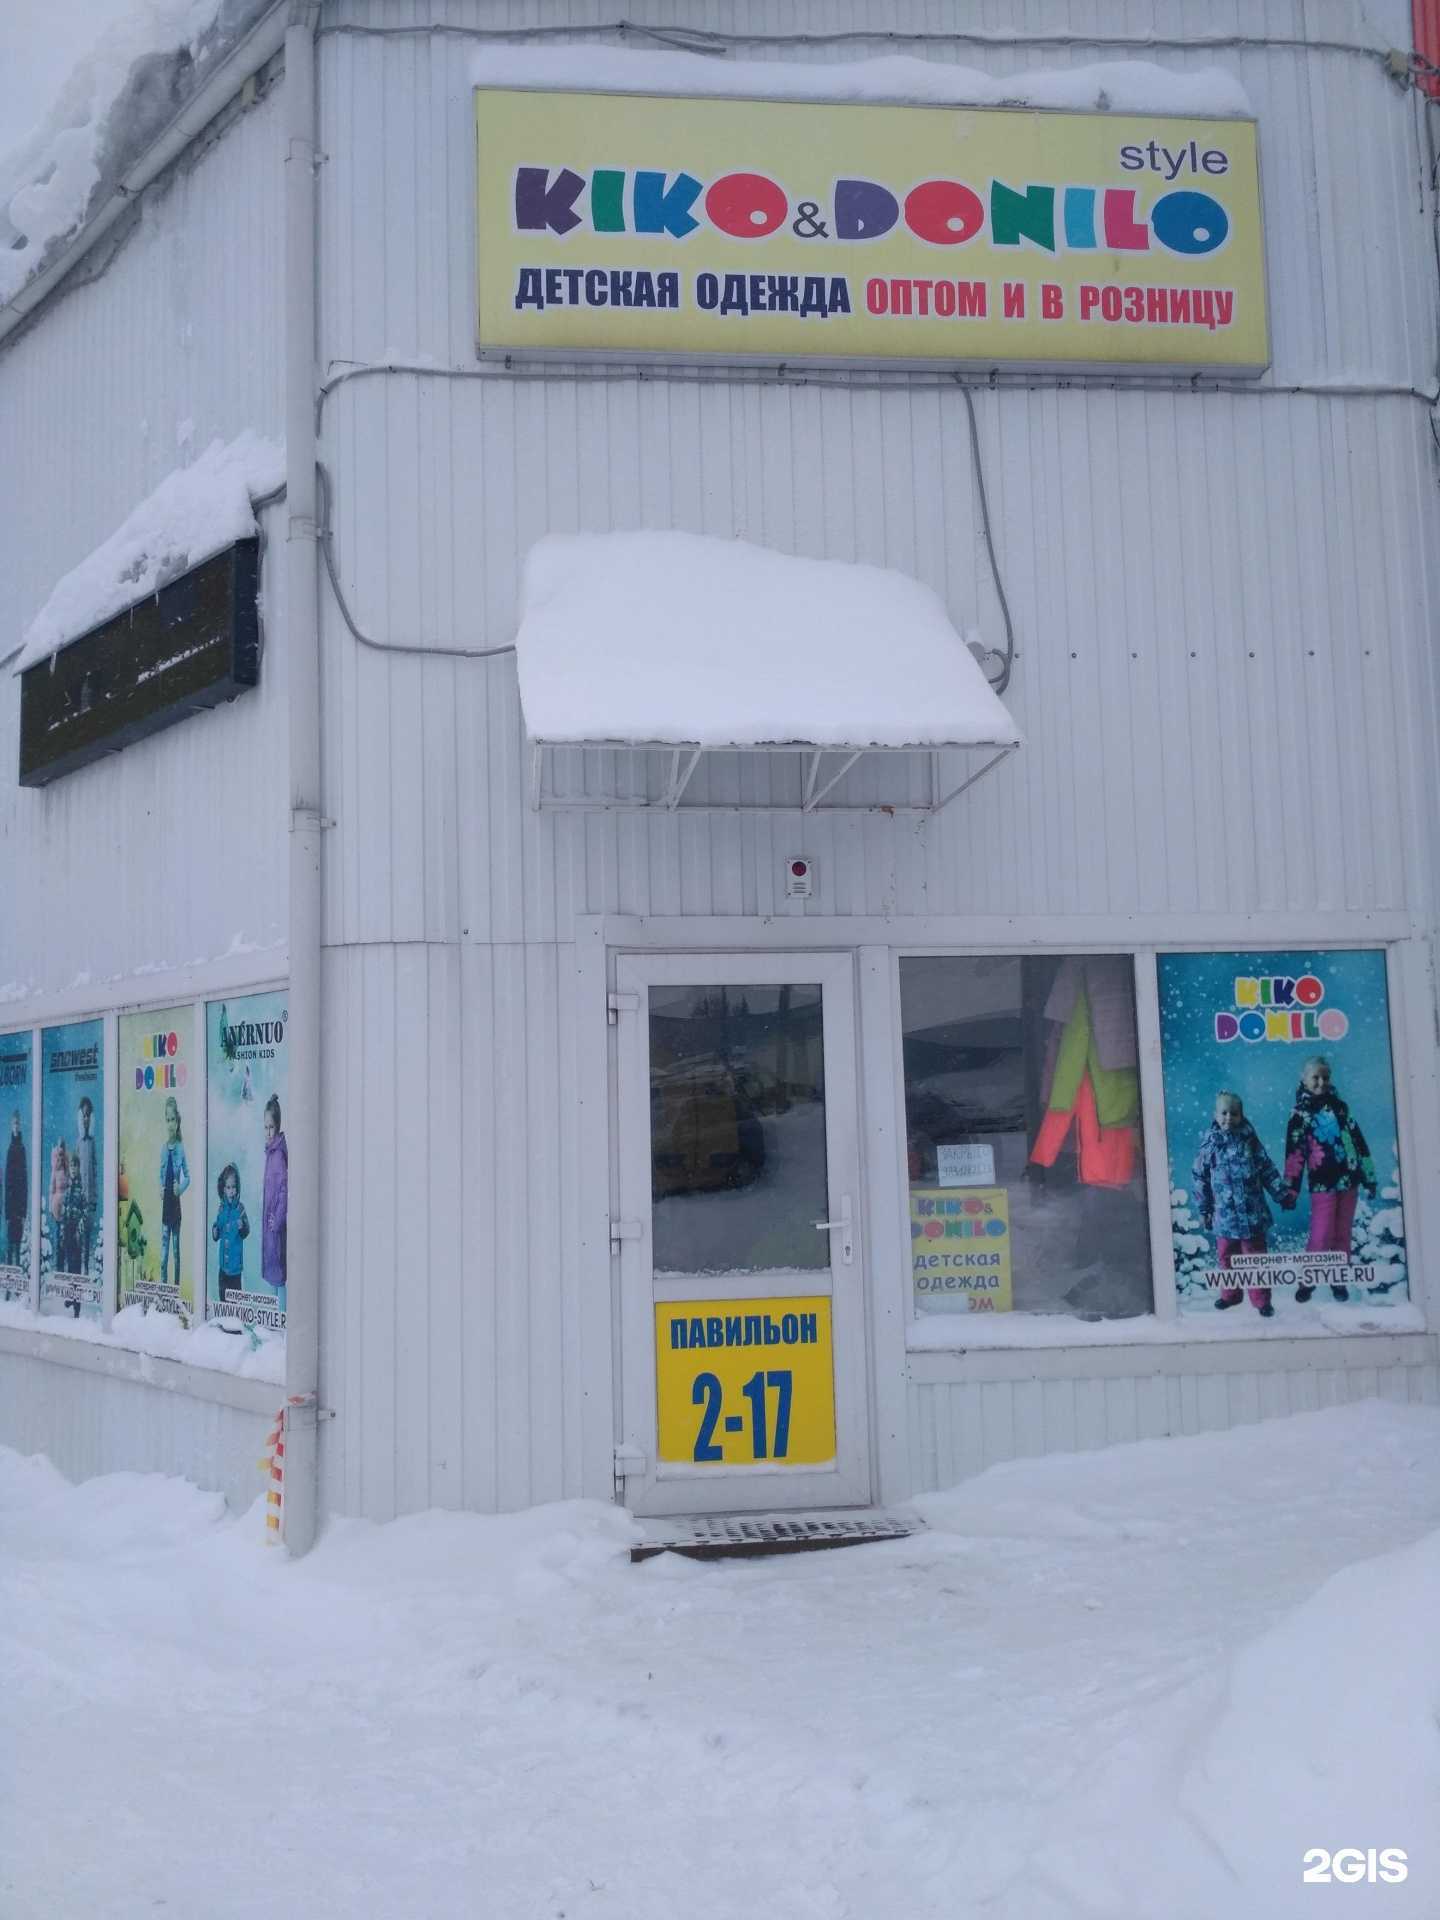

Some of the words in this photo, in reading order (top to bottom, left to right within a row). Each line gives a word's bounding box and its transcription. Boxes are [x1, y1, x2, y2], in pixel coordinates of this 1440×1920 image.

[1119, 141, 1229, 181] style
[515, 268, 679, 310] ДЕТСКАЯ
[696, 272, 851, 318] ОДЕЖДА
[866, 278, 987, 318] ОПТОМ
[1003, 283, 1025, 318] И
[1042, 284, 1064, 320] В
[1080, 285, 1234, 330] РОЗНИЦУ
[1235, 975, 1325, 1009] KIKO
[1215, 1009, 1349, 1042] DONILO
[143, 1031, 178, 1059] KIKO
[258, 1048, 275, 1059] KIDS
[135, 1063, 188, 1090] DONILO
[914, 1252, 1001, 1270] детская
[1232, 1252, 1346, 1266] интернет-магазин:
[917, 1274, 1000, 1291] одежда
[1205, 1267, 1376, 1288] WWW.KIKO-STYLE.RU
[670, 1313, 818, 1349] ПАВИЛЬОН
[692, 1370, 793, 1462] 2-17
